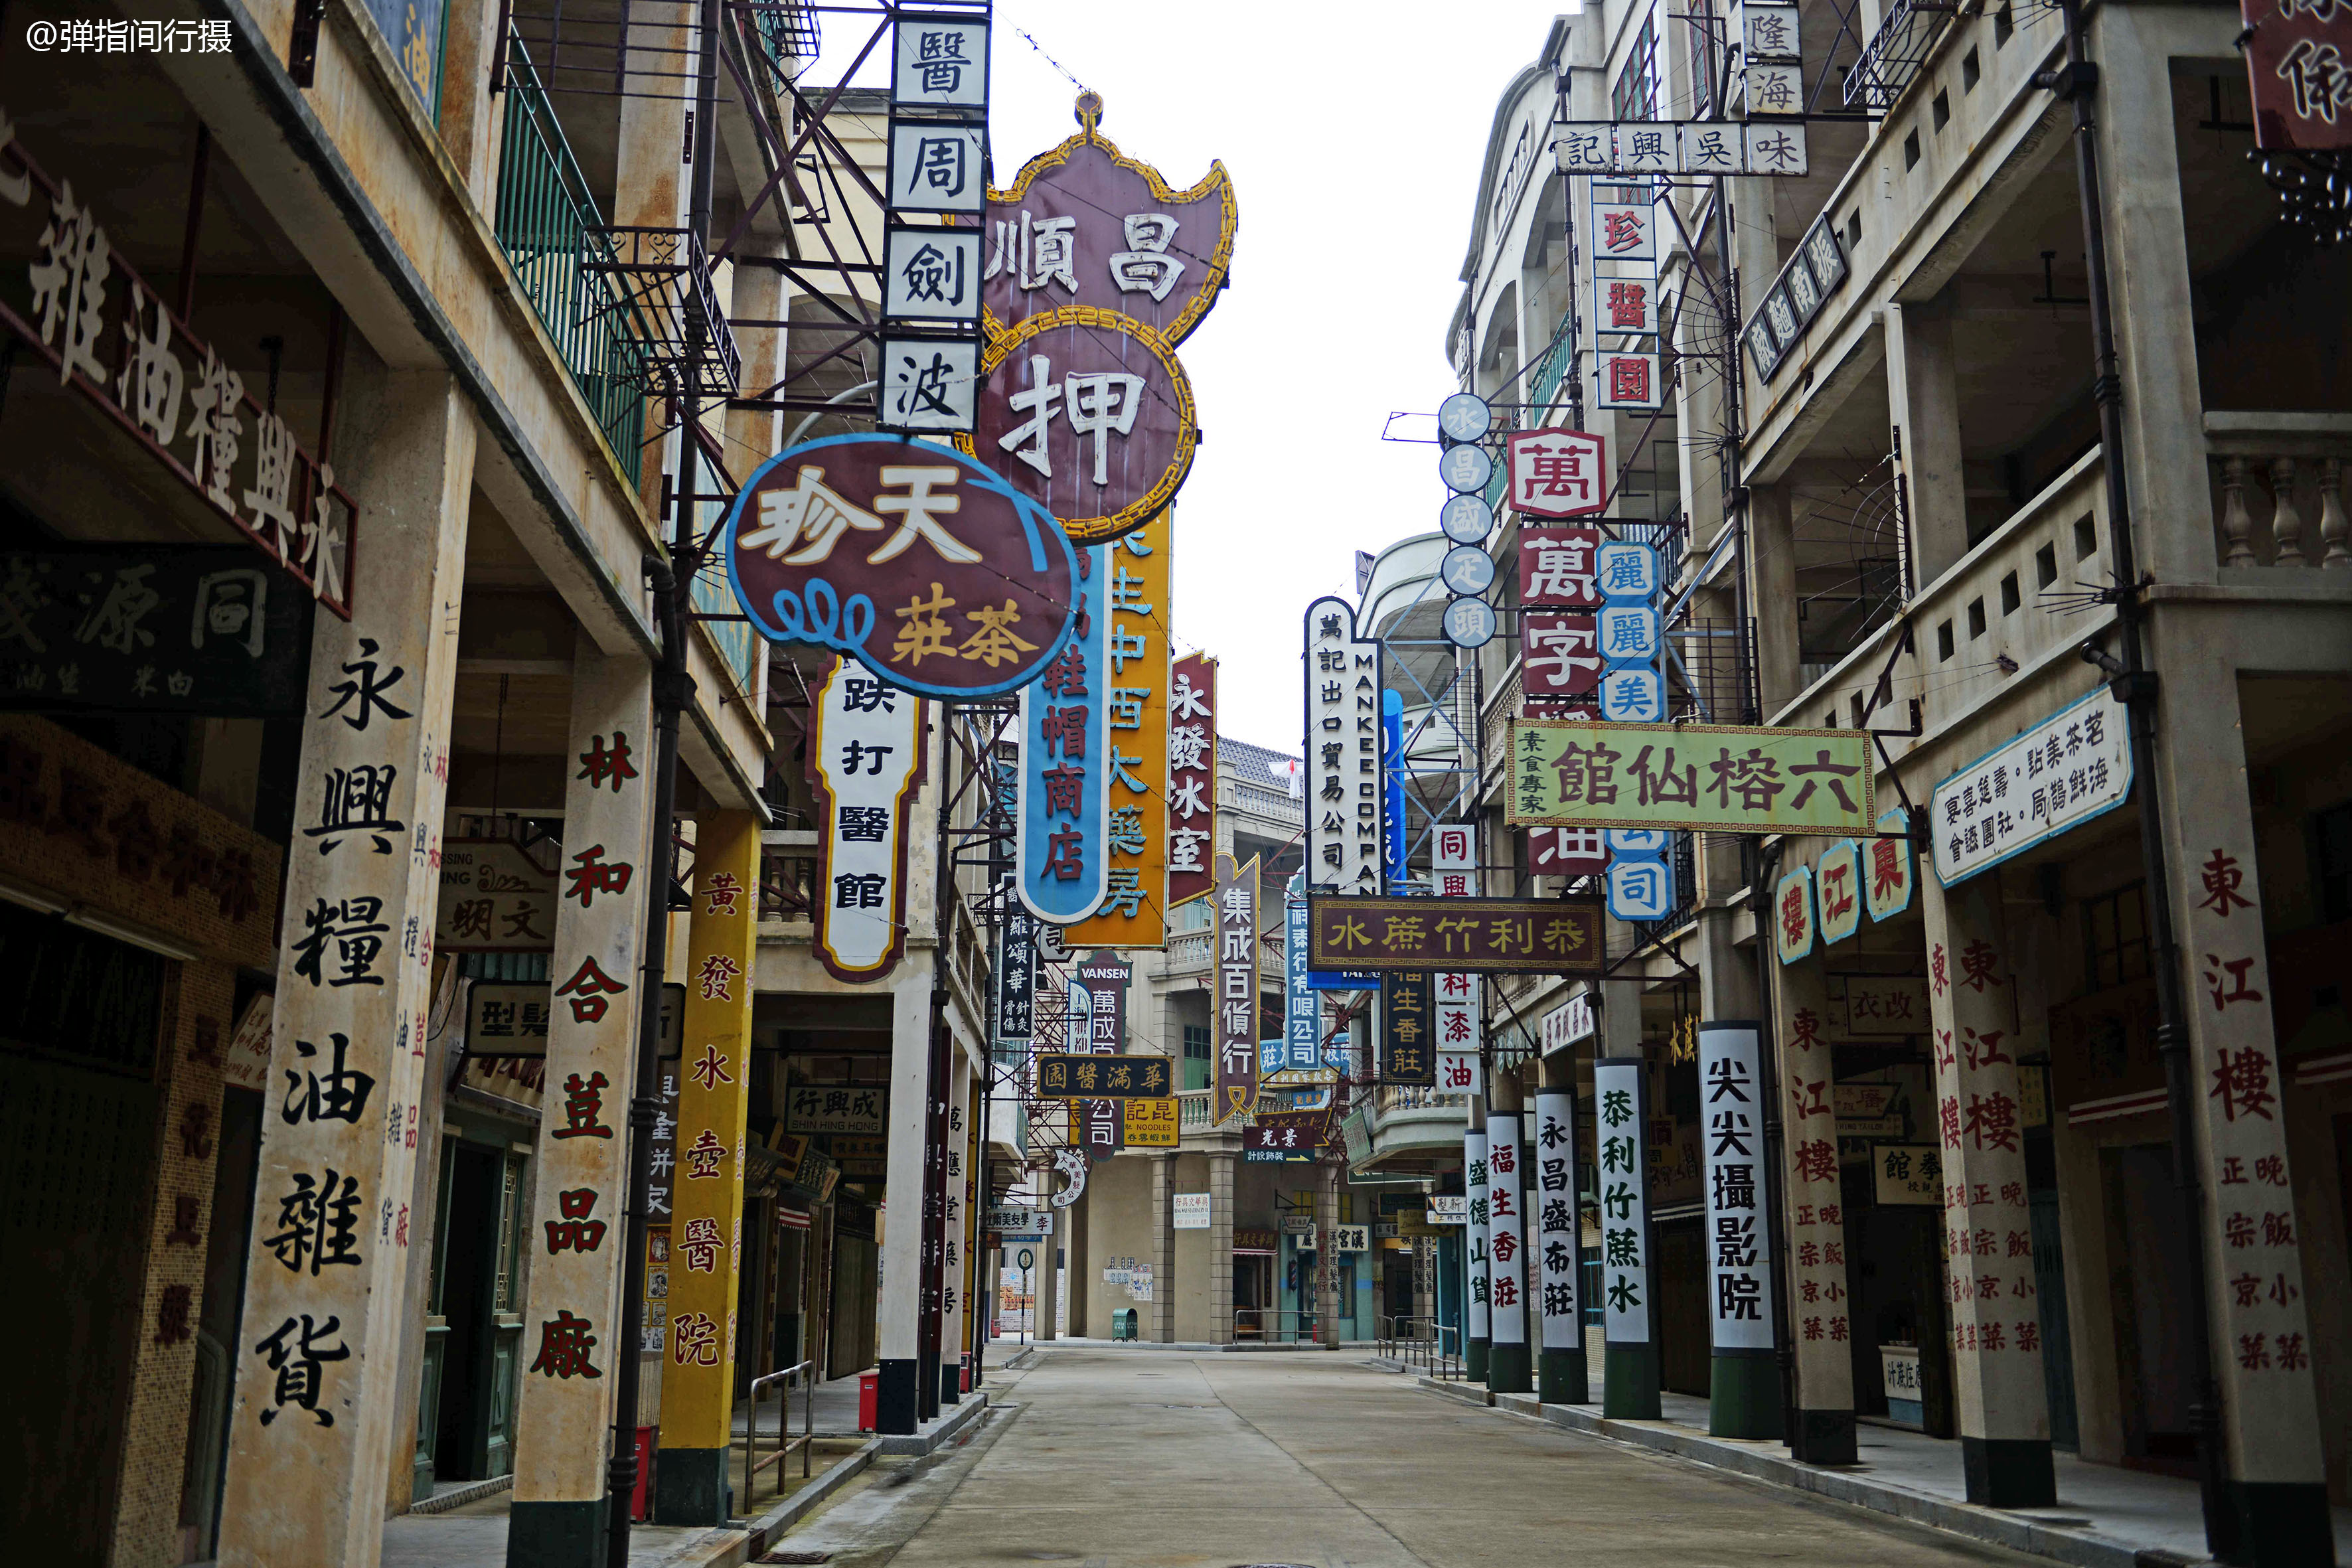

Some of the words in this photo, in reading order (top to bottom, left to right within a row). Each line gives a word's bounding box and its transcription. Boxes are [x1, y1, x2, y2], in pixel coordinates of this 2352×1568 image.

[0, 103, 343, 603] 永興糧油雜
[1604, 174, 1650, 403] 珍醬園
[998, 354, 1146, 485] 押
[1519, 443, 1593, 499] 萬
[833, 678, 896, 910] 跌打醫館
[1040, 548, 1091, 880] 鞋帽商店
[1168, 673, 1214, 873] 永發冰室
[1518, 730, 1547, 814] 素食專家
[1551, 742, 1861, 815] 六榕仙館
[256, 637, 415, 1429] 永興糧油雜貨
[1081, 968, 1129, 979] VANSEN
[1221, 888, 1253, 1074] 集成百貨行
[672, 871, 744, 1368] 黃發水壺醫院
